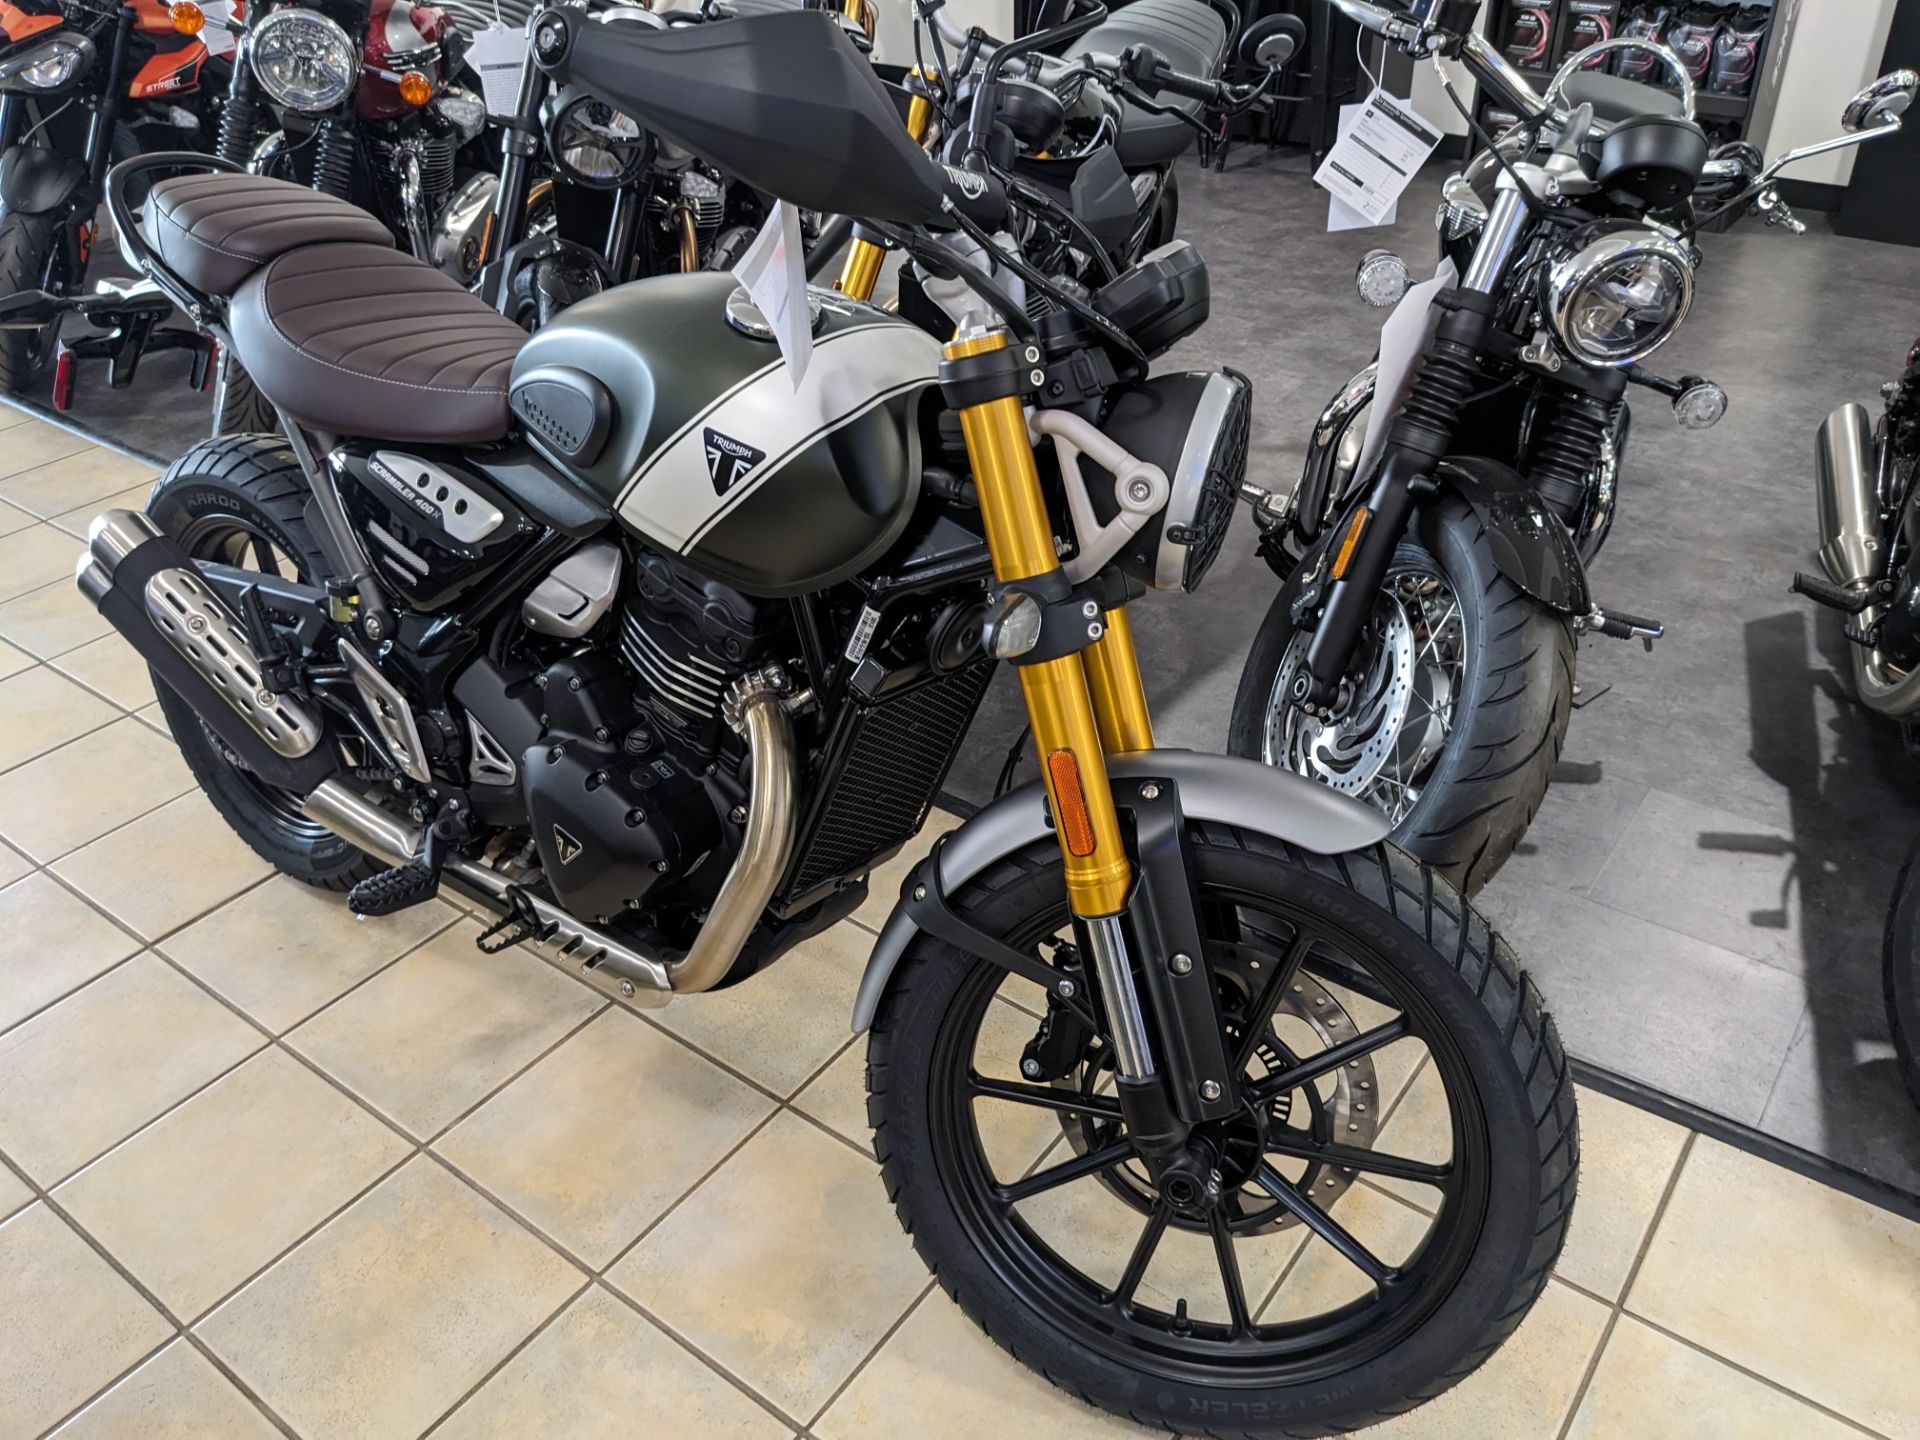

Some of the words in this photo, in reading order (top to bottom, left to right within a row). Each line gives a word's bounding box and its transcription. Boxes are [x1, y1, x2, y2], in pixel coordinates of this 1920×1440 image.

[146, 76, 181, 93] STREET
[941, 164, 989, 200] TRIUMPH
[713, 434, 752, 458] TRIUMPH
[370, 461, 416, 501] SCRAMBLER
[187, 492, 241, 511] KAROO
